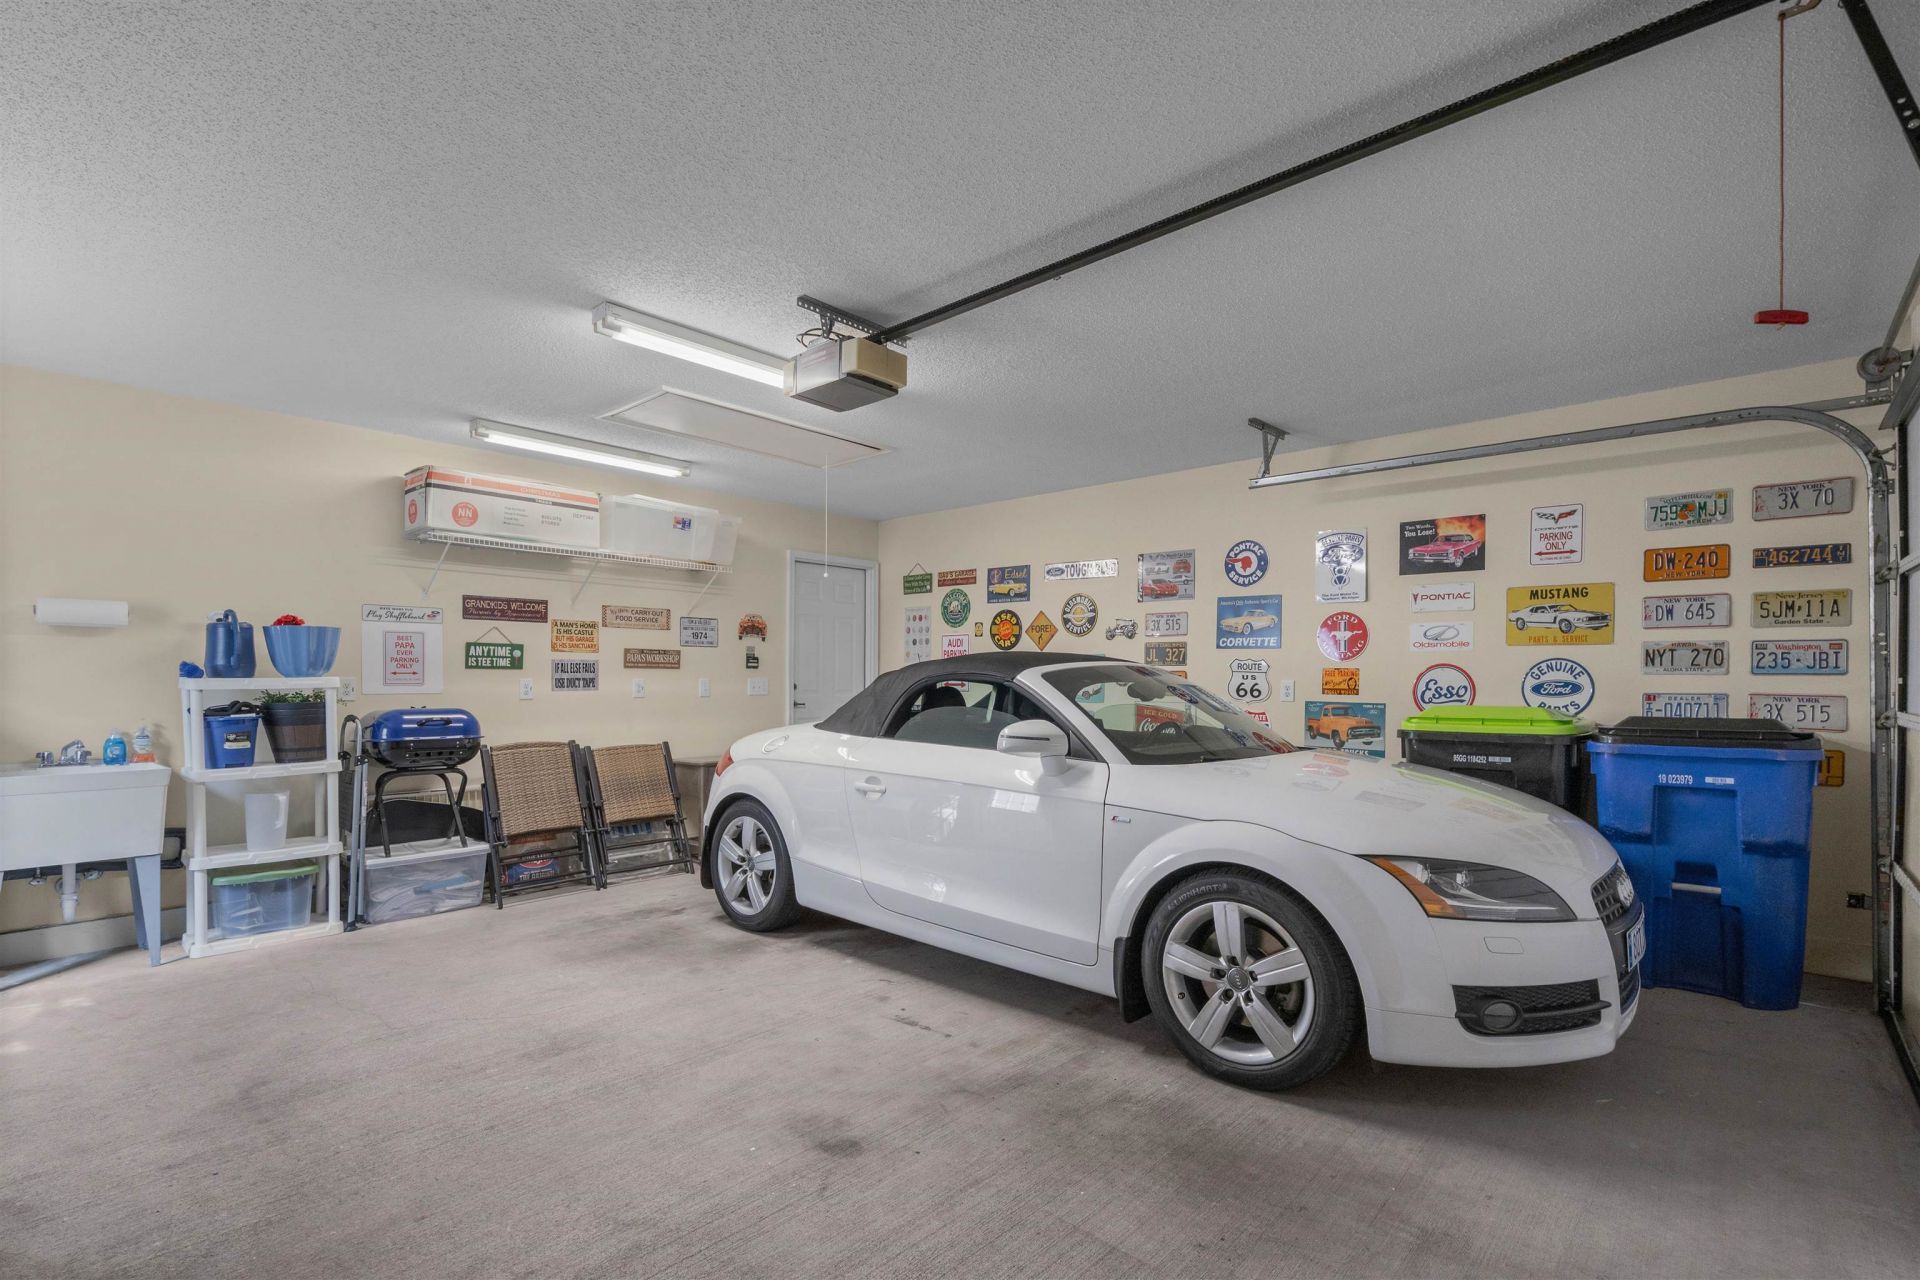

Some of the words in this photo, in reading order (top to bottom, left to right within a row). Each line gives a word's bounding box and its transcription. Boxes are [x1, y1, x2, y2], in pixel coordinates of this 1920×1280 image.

[1778, 491, 1799, 510] 3X
[1813, 488, 1834, 507] 70
[1650, 504, 1678, 522] 759
[1697, 499, 1727, 518] MJJ
[1417, 528, 1435, 536] Lose!
[1540, 531, 1573, 541] PARKING
[1229, 543, 1264, 557] PONTIAC
[1545, 541, 1566, 550] ONLY
[1769, 547, 1832, 564] 462744
[1004, 568, 1027, 579] Edsel
[1228, 570, 1262, 584] SERVICE
[1665, 570, 1682, 578] NEW
[1420, 592, 1471, 601] PONTIAC
[1529, 587, 1589, 600] MUSTANG
[465, 600, 508, 610] GRANDKIDS
[510, 602, 547, 612] WELCOME
[1064, 596, 1095, 613] OLDSMOBILE
[366, 609, 382, 620] Play
[384, 610, 426, 621] Shuffleboard
[1655, 604, 1674, 621] DW
[1685, 603, 1715, 620] 645
[995, 613, 1017, 625] USED
[1151, 619, 1161, 631] 3X
[1165, 619, 1181, 631] 515
[1327, 614, 1358, 625] FORD
[1031, 625, 1052, 633] FORE!
[1066, 623, 1092, 634] SERVICE
[691, 631, 708, 640] 1974
[994, 635, 1016, 648] CARS
[947, 638, 964, 647] AUDI
[1220, 637, 1278, 647] CORVETTE
[1776, 643, 1823, 651] Washington
[469, 646, 512, 657] ANYTIME
[1146, 648, 1159, 661] JL
[1166, 648, 1185, 661] 327
[1322, 640, 1364, 658] MUSTANG
[468, 657, 476, 666] IS
[477, 657, 491, 667] TEE
[492, 657, 511, 667] TIME
[646, 654, 679, 663] WORKSHOP
[1645, 649, 1677, 667] NYT
[1690, 648, 1724, 667] 270
[555, 662, 560, 674] IF
[560, 662, 569, 674] ALL
[570, 662, 581, 674] ELSE
[582, 662, 596, 674] FAILS
[1237, 663, 1262, 671] ROUTE
[1530, 661, 1584, 680] GENUINE
[555, 678, 566, 688] USE
[566, 678, 581, 688] DUCT
[582, 677, 596, 688] TAPE
[1540, 682, 1572, 694] Ford
[1235, 682, 1262, 698] 66
[1420, 679, 1468, 704] Esso
[1763, 703, 1784, 721] 3X
[1796, 705, 1831, 723] 515
[1658, 774, 1667, 784] 19
[1667, 774, 1693, 784] 023979
